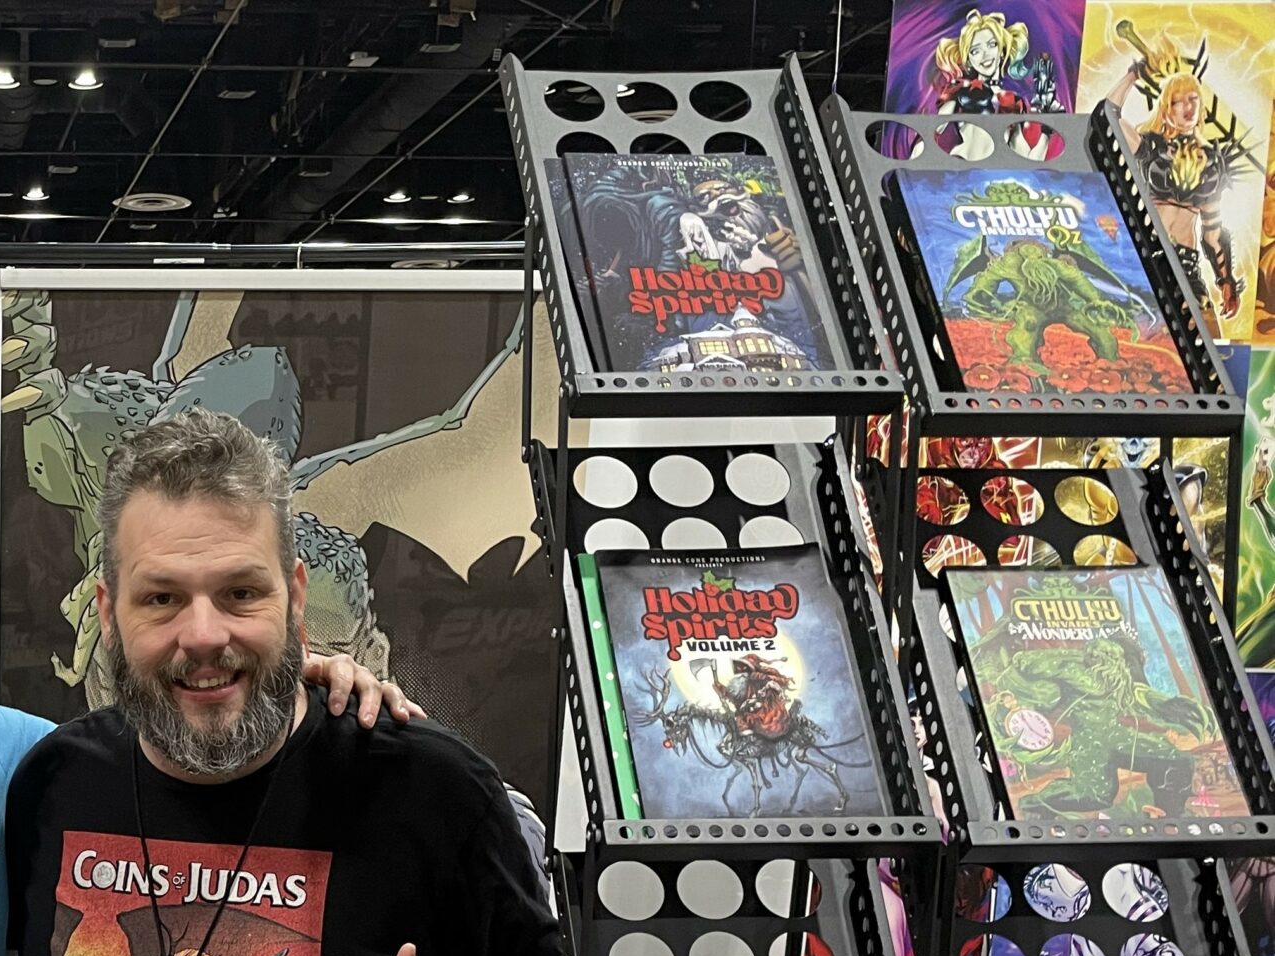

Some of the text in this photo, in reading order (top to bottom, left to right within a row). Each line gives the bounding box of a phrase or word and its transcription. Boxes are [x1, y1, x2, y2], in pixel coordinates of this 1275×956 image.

[955, 205, 1080, 229] CTHULHU
[981, 226, 1045, 236] INVADES
[629, 264, 783, 299] Holiday
[629, 290, 763, 333] Spirits
[643, 584, 799, 620] Holiday
[1013, 600, 1122, 621] CTHULHU
[642, 614, 778, 661] Spirits
[1046, 620, 1101, 628] INVADES
[686, 639, 776, 652] VOLUME 2
[73, 850, 307, 908] COINS OF JUDAS
